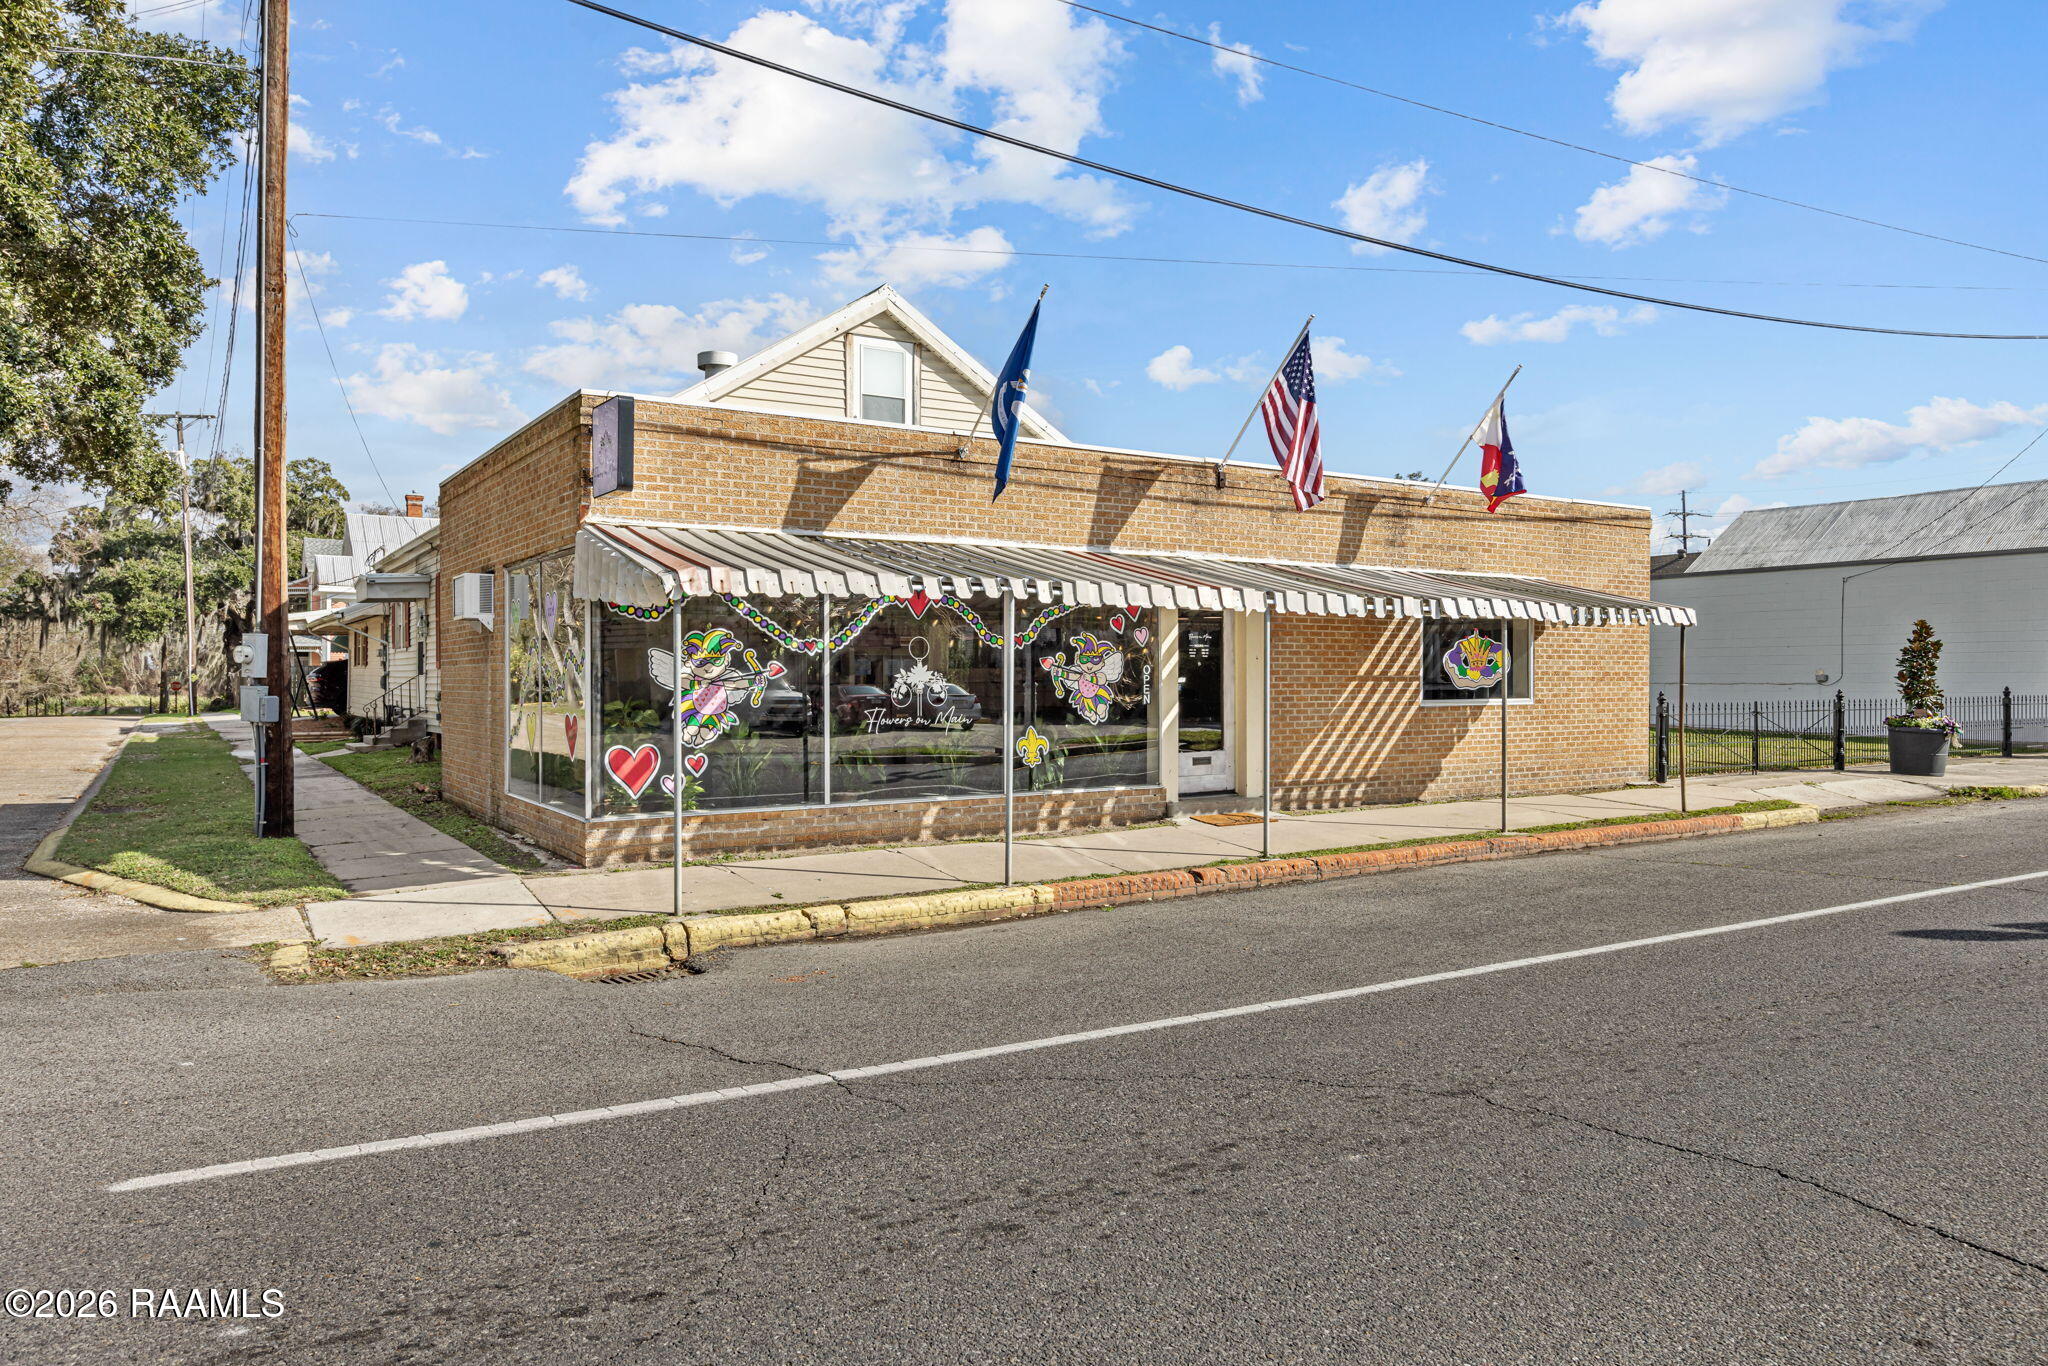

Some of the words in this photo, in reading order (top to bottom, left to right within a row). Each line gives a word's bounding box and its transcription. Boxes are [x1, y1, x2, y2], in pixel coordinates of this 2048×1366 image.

[1143, 664, 1151, 704] OPEN
[864, 707, 913, 734] Flowers
[915, 716, 932, 726] on
[934, 705, 973, 736] Main
